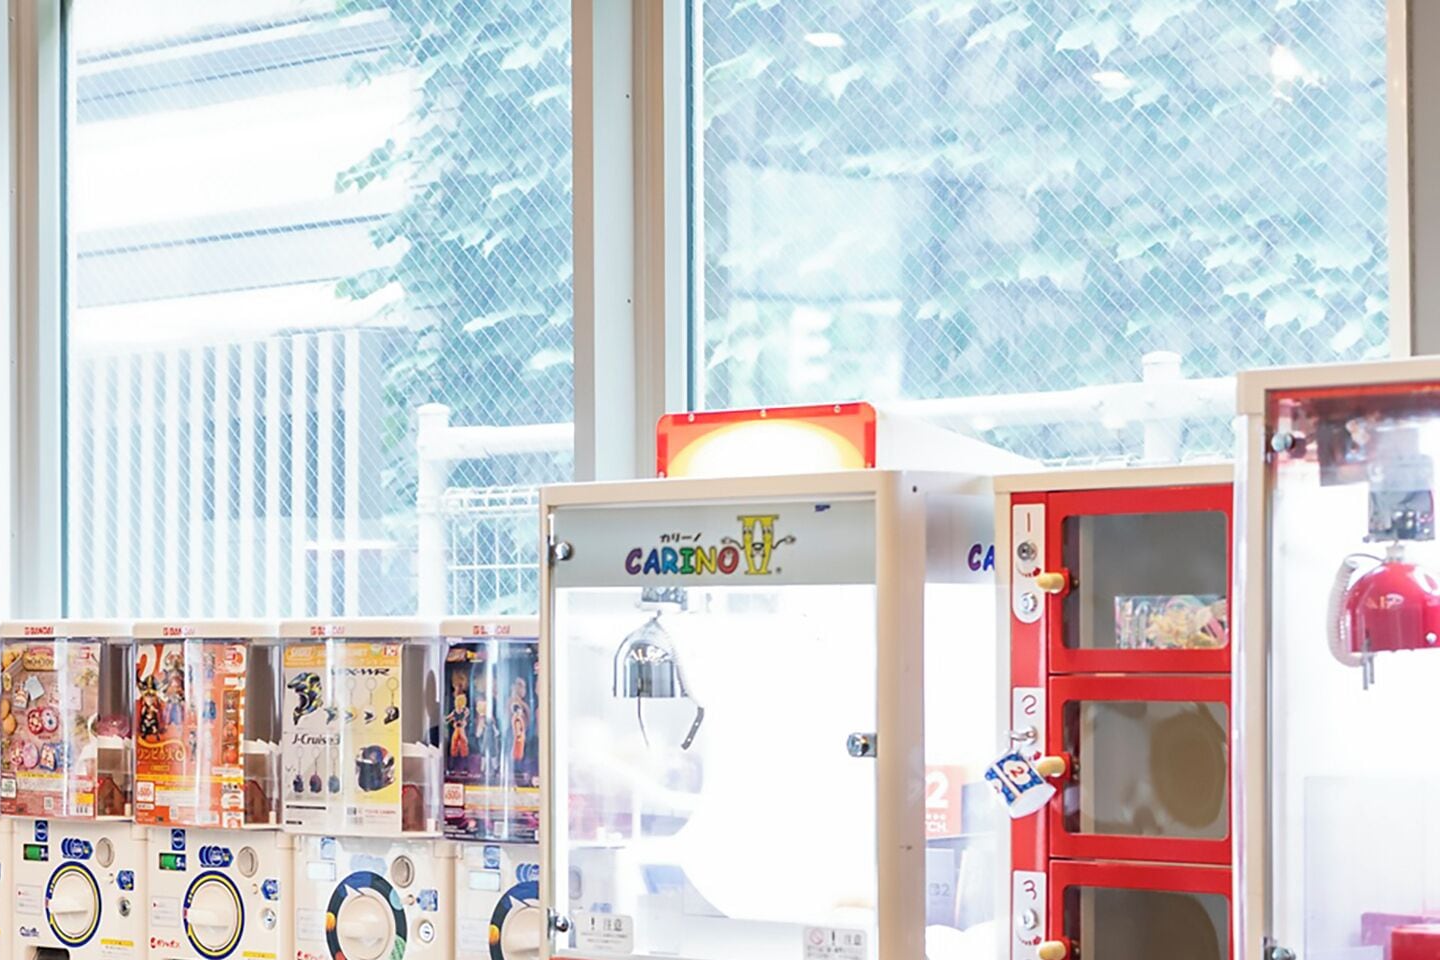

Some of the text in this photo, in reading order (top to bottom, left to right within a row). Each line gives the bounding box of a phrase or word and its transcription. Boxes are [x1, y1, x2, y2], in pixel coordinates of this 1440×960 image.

[659, 532, 703, 544] カリーノ
[625, 545, 740, 576] CARINO
[1021, 695, 1038, 716] 2
[1023, 879, 1038, 901] 3
